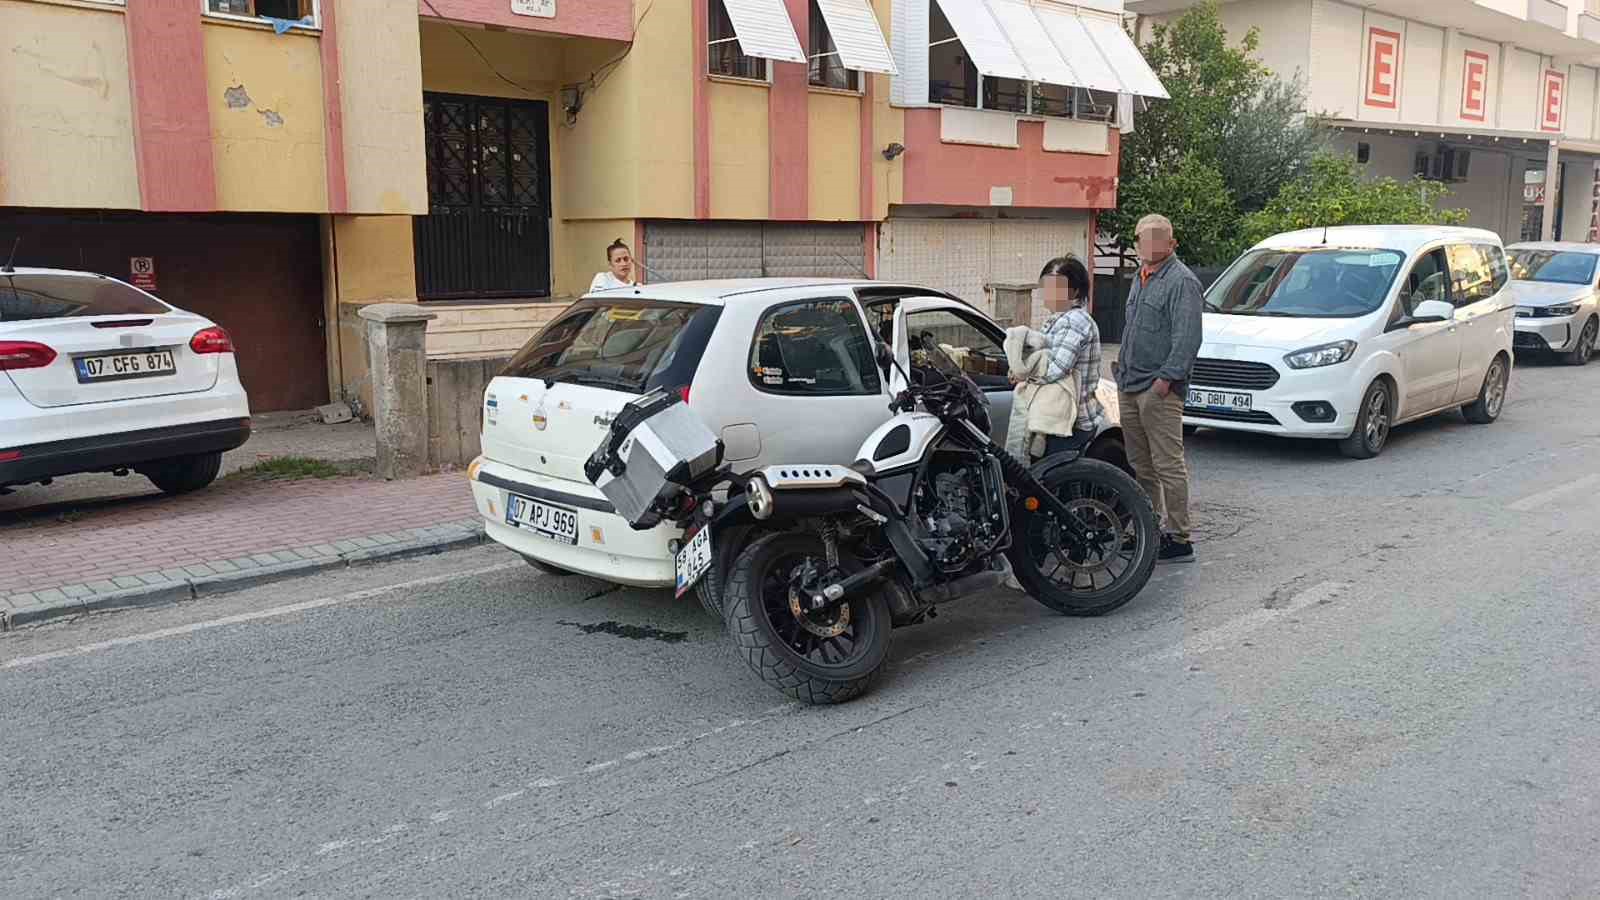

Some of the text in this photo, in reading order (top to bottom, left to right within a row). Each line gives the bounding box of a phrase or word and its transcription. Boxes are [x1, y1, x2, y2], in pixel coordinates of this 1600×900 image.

[1372, 41, 1393, 96] E
[1466, 62, 1483, 110] E
[1546, 79, 1560, 122] E
[86, 354, 172, 375] 07 CFG 874
[529, 504, 550, 528] APJ
[553, 511, 575, 535] 969
